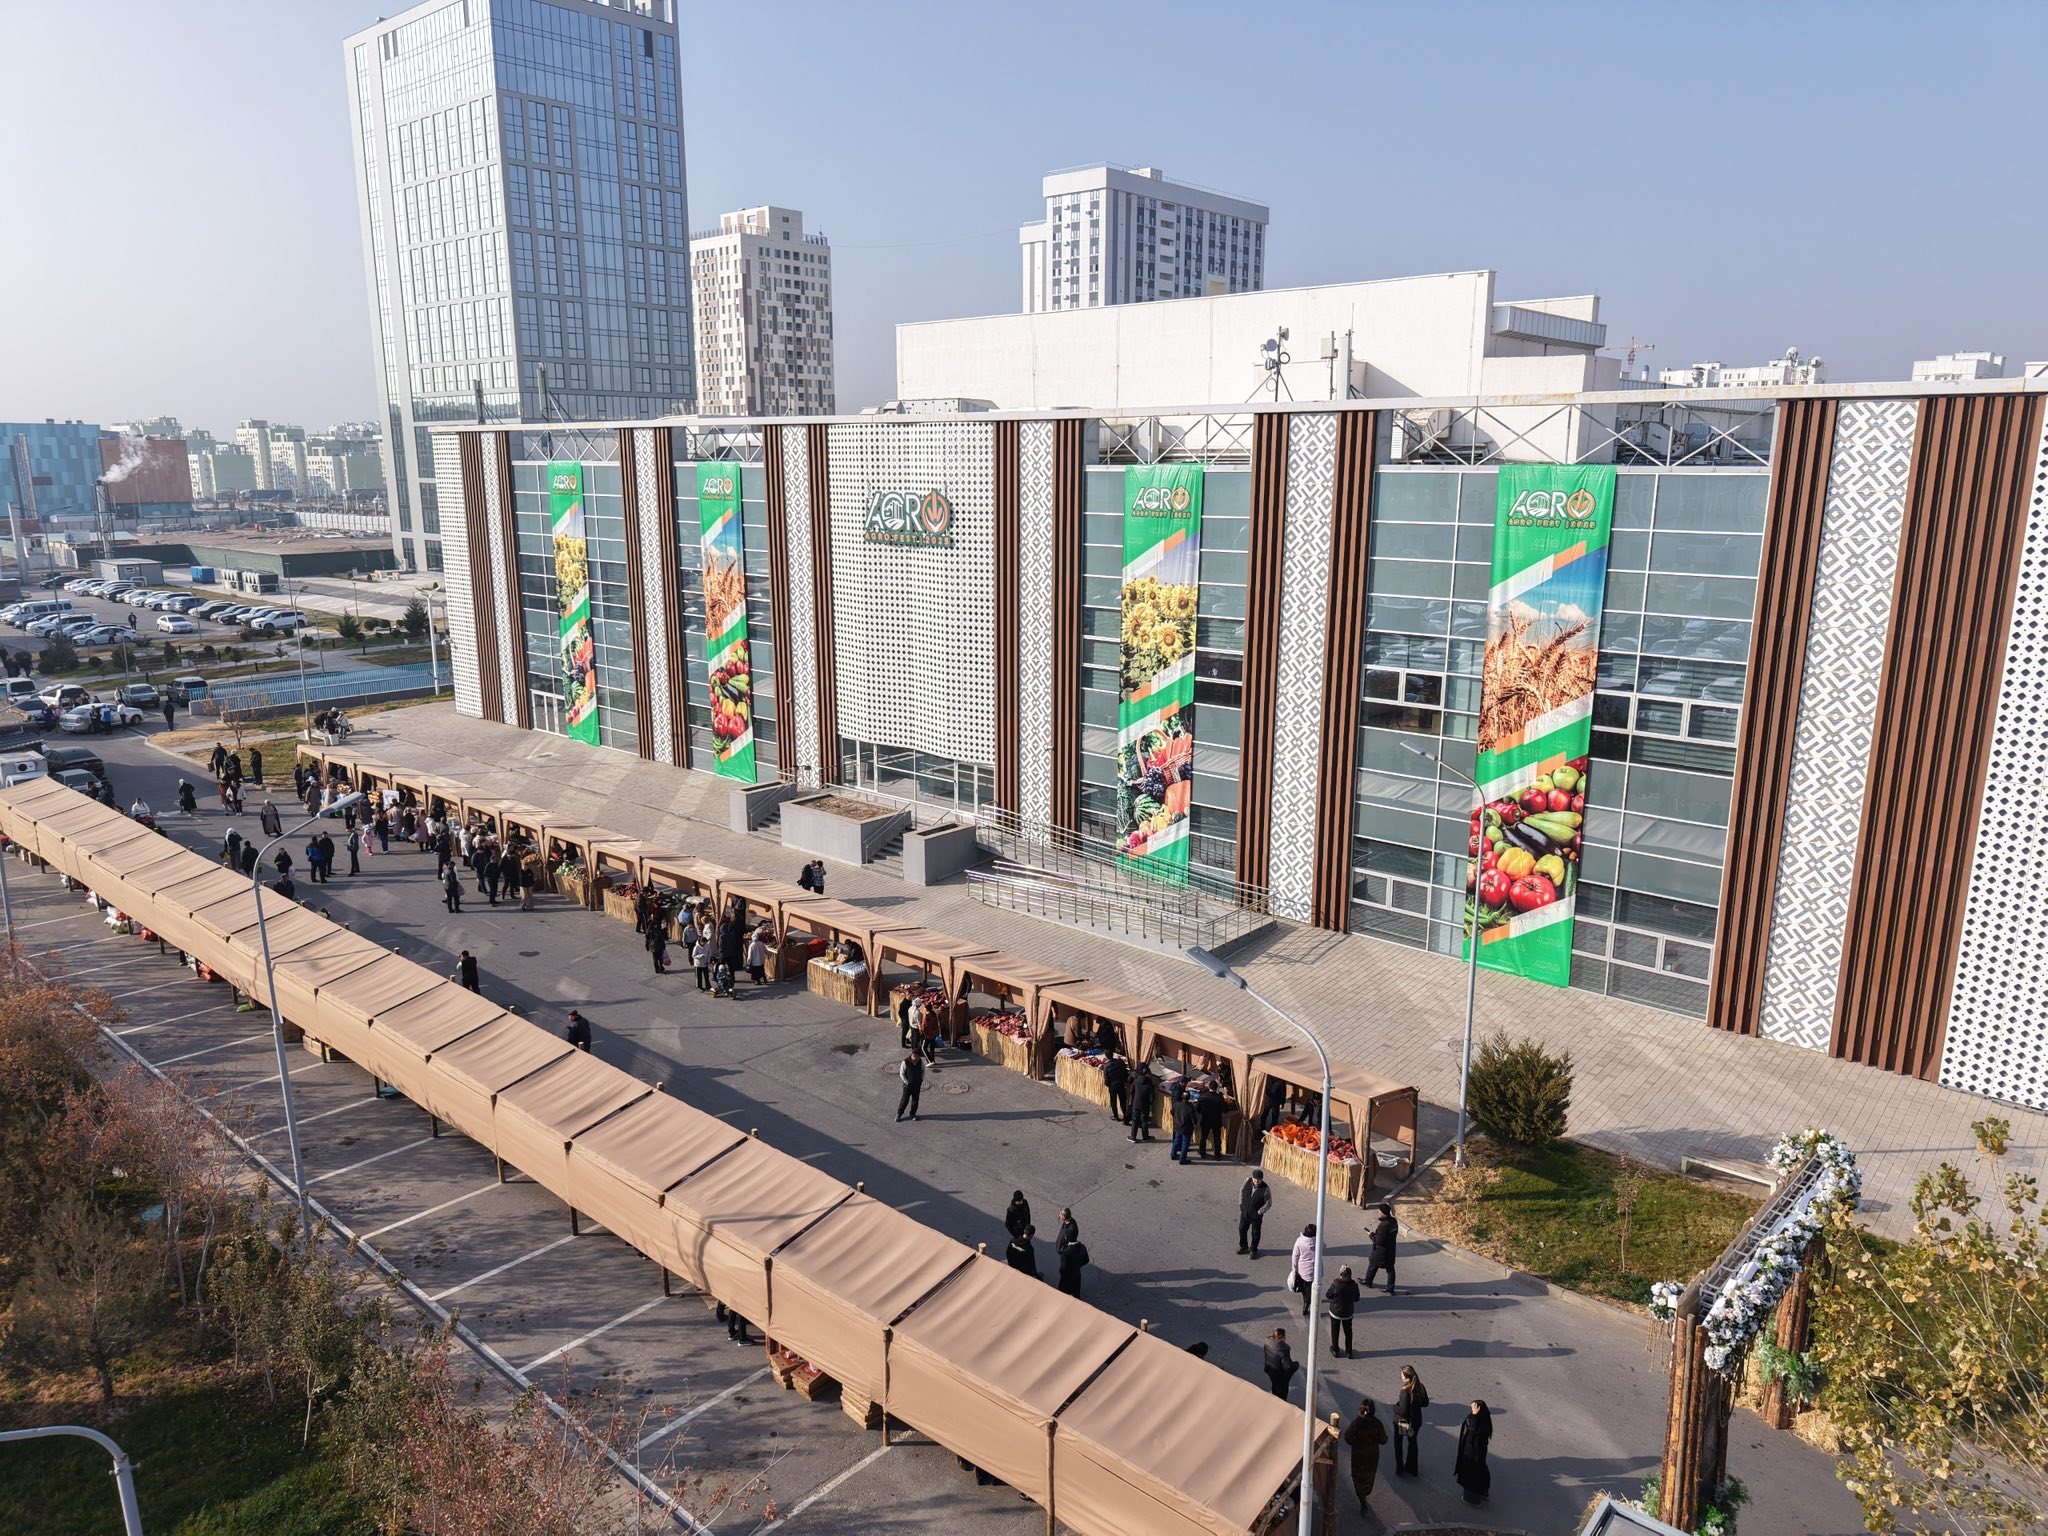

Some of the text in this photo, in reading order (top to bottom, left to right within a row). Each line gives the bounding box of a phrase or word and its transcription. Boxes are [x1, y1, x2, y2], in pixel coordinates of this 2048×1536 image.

[864, 489, 950, 533] AGRO
[1132, 486, 1190, 511] AGRO
[1509, 489, 1596, 519] AGRO
